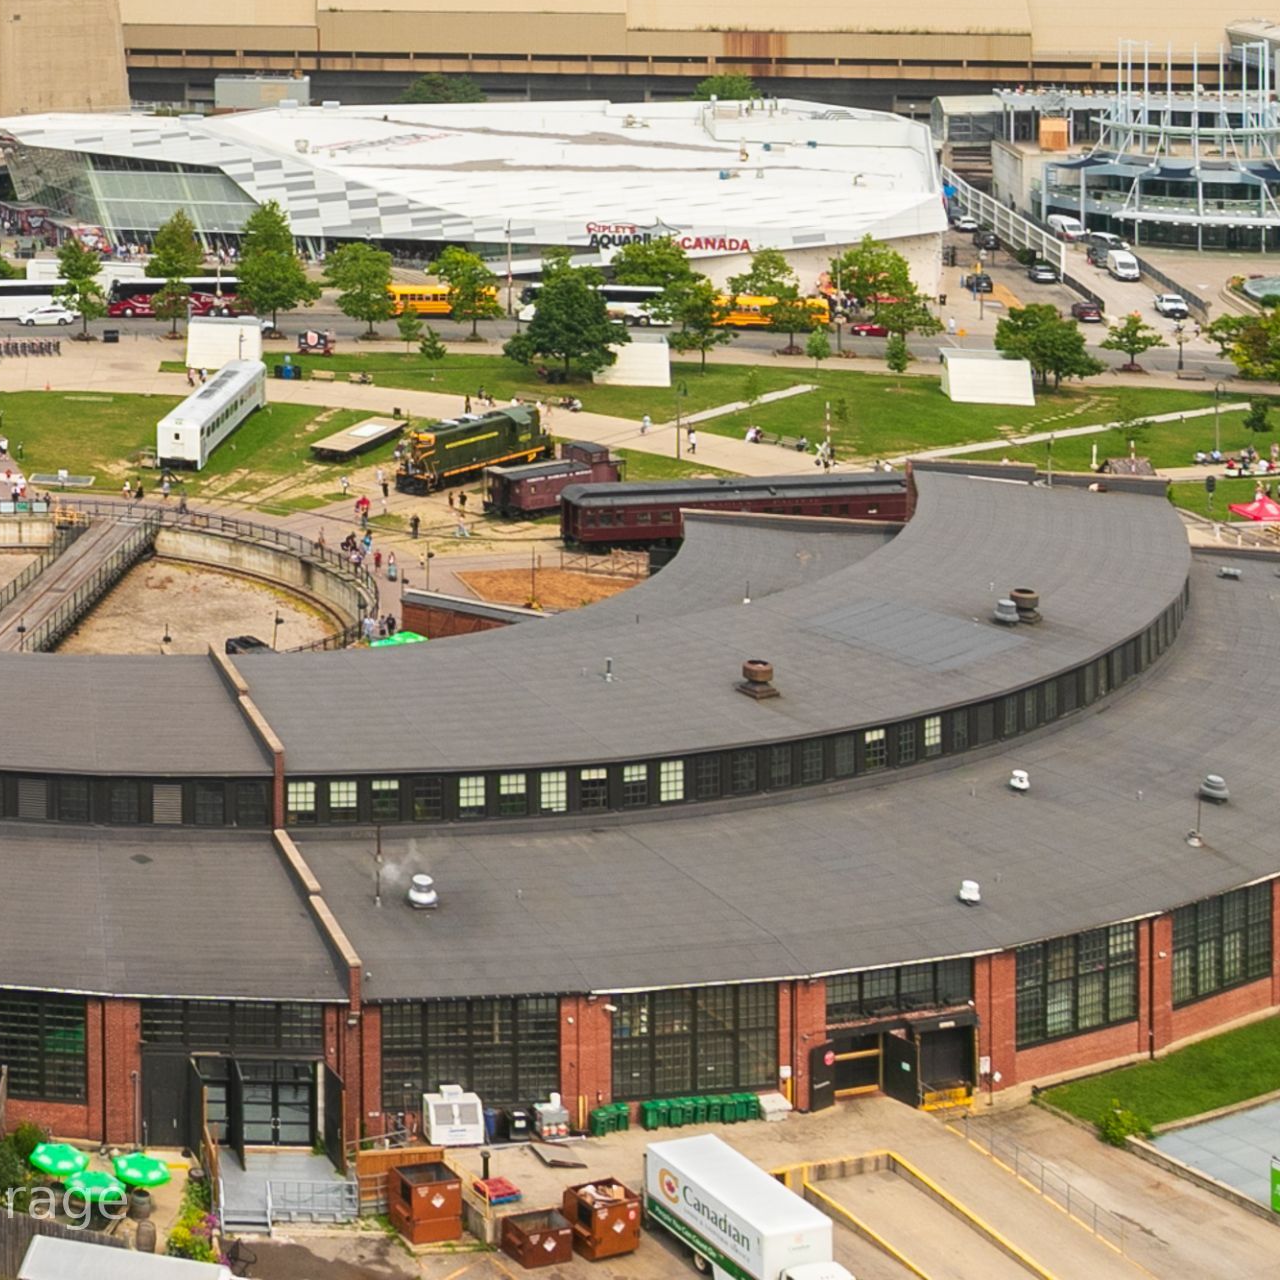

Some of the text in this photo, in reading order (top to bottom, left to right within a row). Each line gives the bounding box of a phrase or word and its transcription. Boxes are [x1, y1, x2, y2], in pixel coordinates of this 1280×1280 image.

[590, 233, 664, 249] AQUARI
[680, 237, 750, 252] CANADA
[682, 1185, 751, 1252] Canadian
